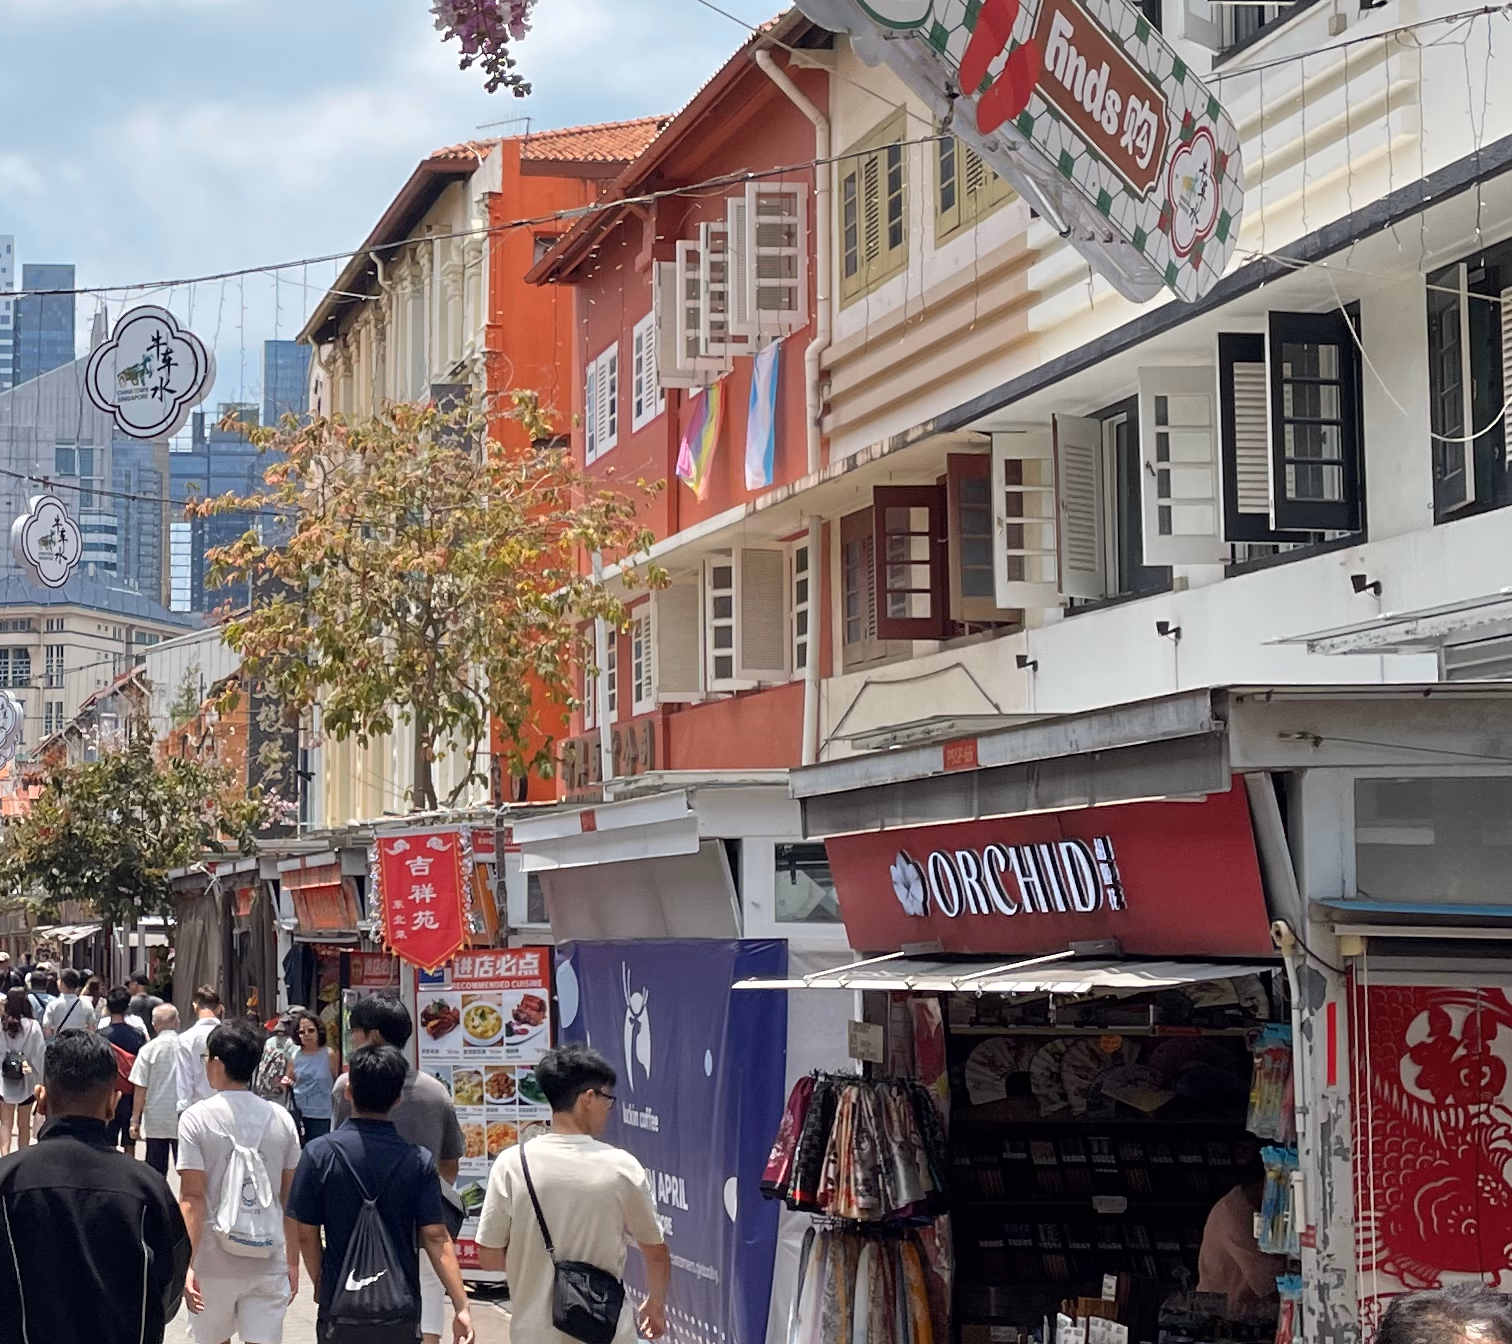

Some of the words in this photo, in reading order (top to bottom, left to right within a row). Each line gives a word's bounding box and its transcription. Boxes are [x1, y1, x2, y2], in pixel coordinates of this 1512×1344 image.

[146, 329, 178, 403] 牛车水
[404, 856, 440, 932] 吉祥苑
[927, 840, 1095, 919] ORCHID
[452, 952, 541, 980] 进店必点
[657, 1170, 689, 1211] APRIL
